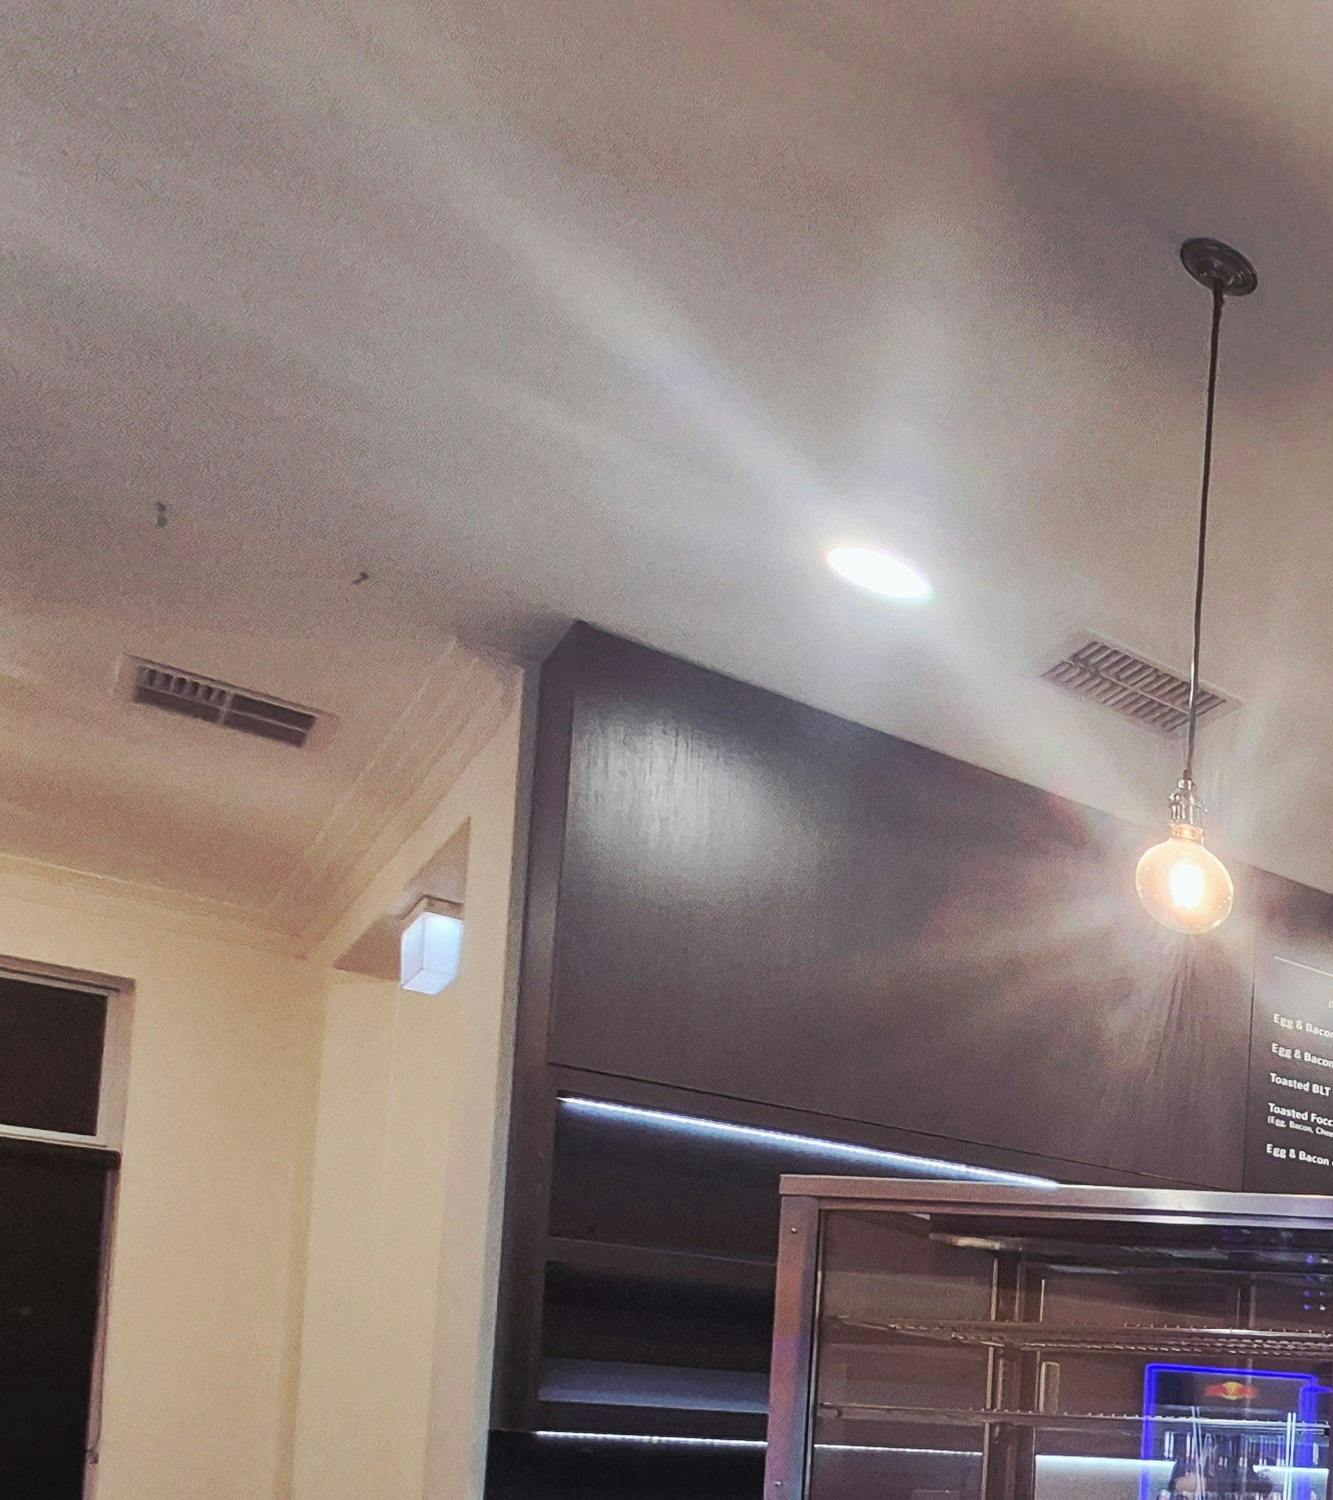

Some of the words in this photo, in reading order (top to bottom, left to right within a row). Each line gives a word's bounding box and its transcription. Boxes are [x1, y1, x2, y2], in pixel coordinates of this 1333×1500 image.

[1273, 1013, 1293, 1030] Egg
[1295, 1019, 1303, 1030] &
[1271, 1042, 1292, 1060] Egg
[1293, 1050, 1301, 1060] &
[1269, 1072, 1310, 1092] Toasted
[1311, 1083, 1332, 1097] BLT
[1267, 1101, 1309, 1121] Toasted
[1266, 1143, 1286, 1160] Egg
[1288, 1148, 1297, 1160] &
[1298, 1151, 1330, 1167] Bacon
